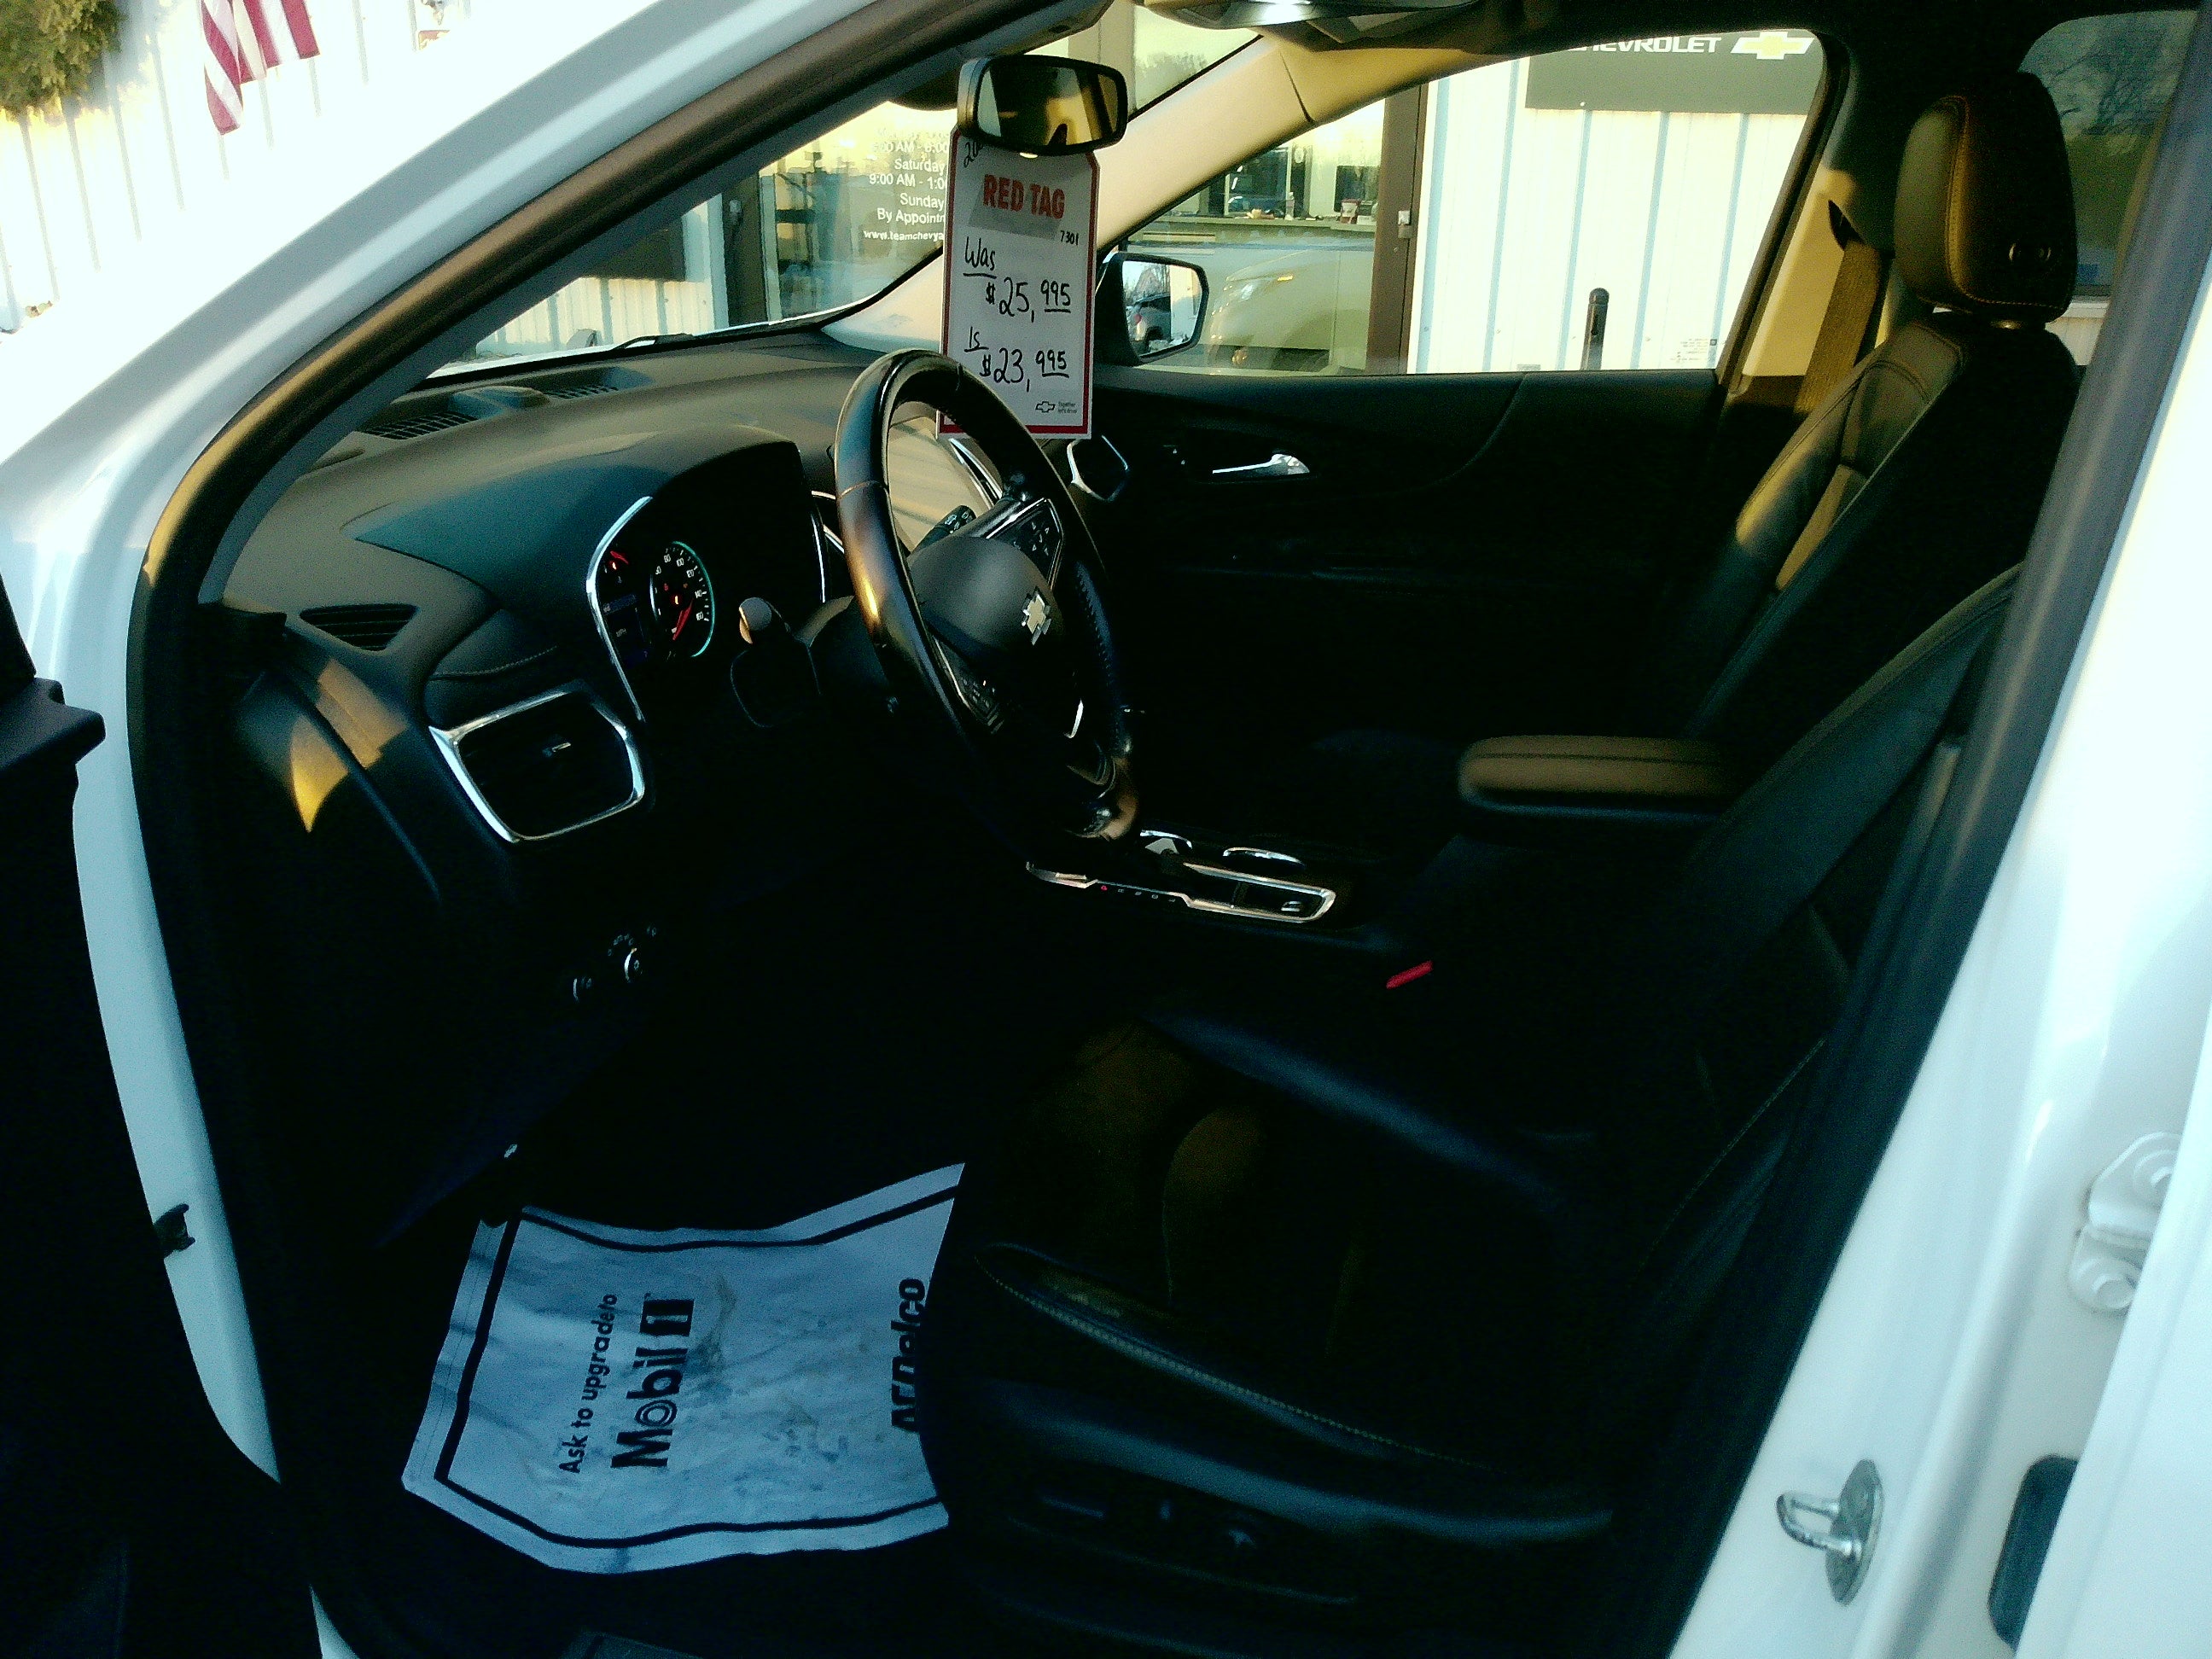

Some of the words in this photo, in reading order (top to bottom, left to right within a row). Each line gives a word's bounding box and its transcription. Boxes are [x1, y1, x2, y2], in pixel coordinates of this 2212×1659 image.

[894, 158, 946, 176] Saturday
[869, 173, 894, 185] 9:00
[896, 173, 916, 188] AM
[899, 192, 945, 212] Sunday
[983, 174, 1024, 212] RED
[1030, 183, 1065, 219] TAG
[876, 207, 893, 224] By
[1060, 230, 1079, 246] 7301
[964, 236, 995, 271] Was
[581, 1311, 615, 1401] upgrade
[570, 1407, 594, 1428] to
[609, 1346, 689, 1469] Mobil
[558, 1435, 589, 1474] Ask
